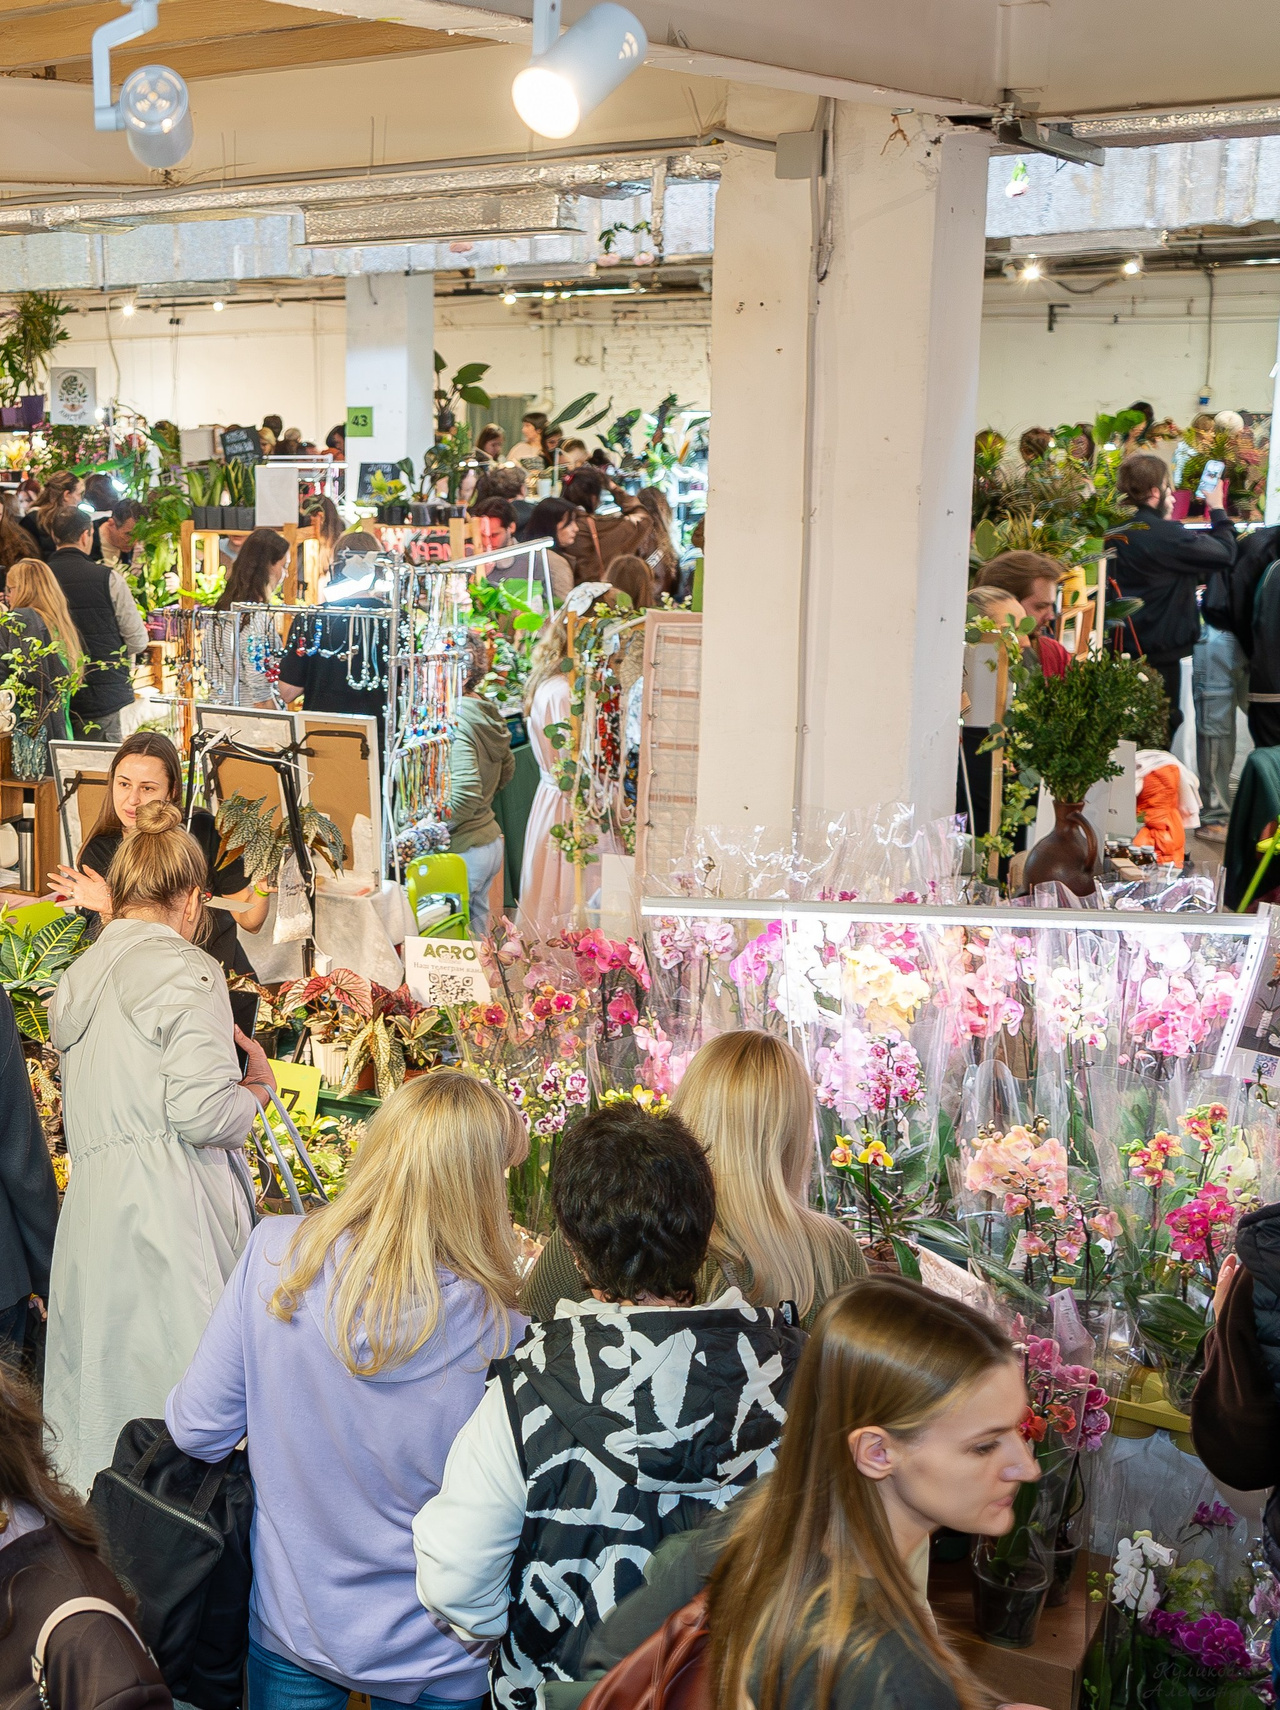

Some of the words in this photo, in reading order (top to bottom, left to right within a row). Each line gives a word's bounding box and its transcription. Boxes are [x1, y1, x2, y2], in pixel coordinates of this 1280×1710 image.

[351, 414, 369, 427] 43
[423, 943, 477, 961] AGRO
[431, 964, 465, 973] телеграм
[279, 1087, 301, 1113] 7
